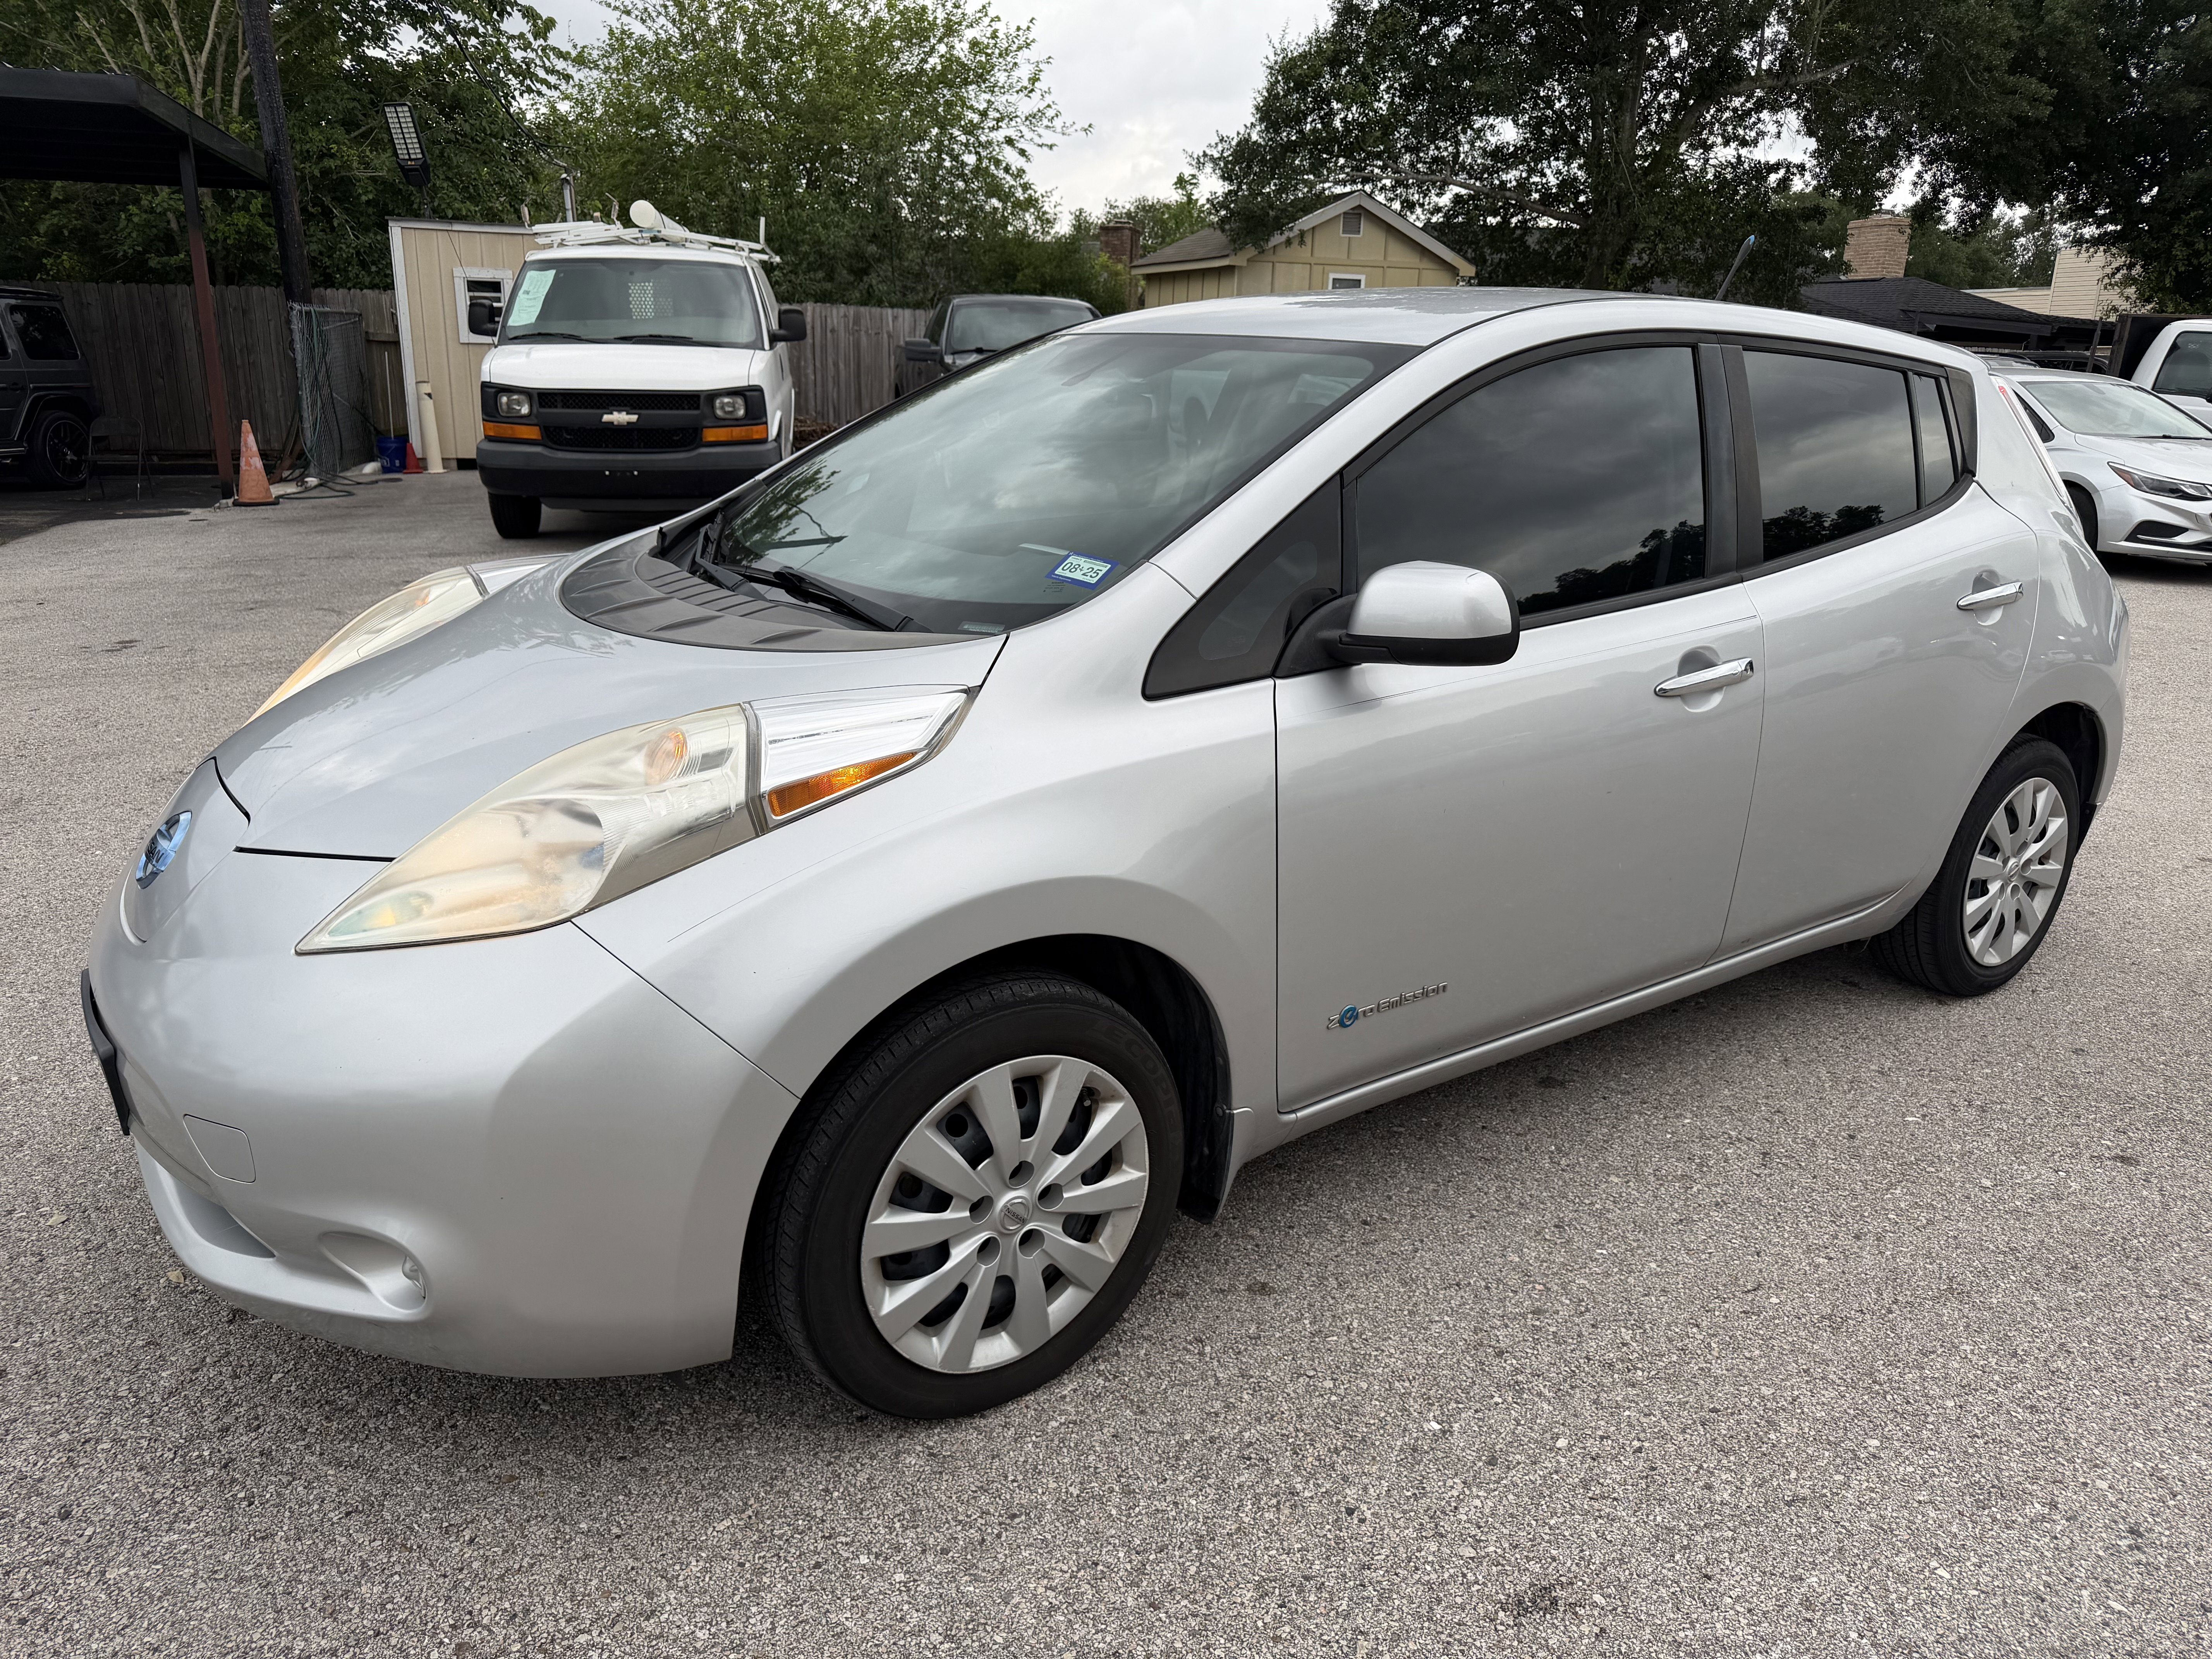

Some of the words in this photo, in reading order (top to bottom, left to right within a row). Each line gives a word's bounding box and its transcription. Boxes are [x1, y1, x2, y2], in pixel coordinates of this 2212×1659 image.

[1061, 562, 1080, 573] 08
[1081, 567, 1102, 578] 25
[1006, 1207, 1025, 1223] NISSAN
